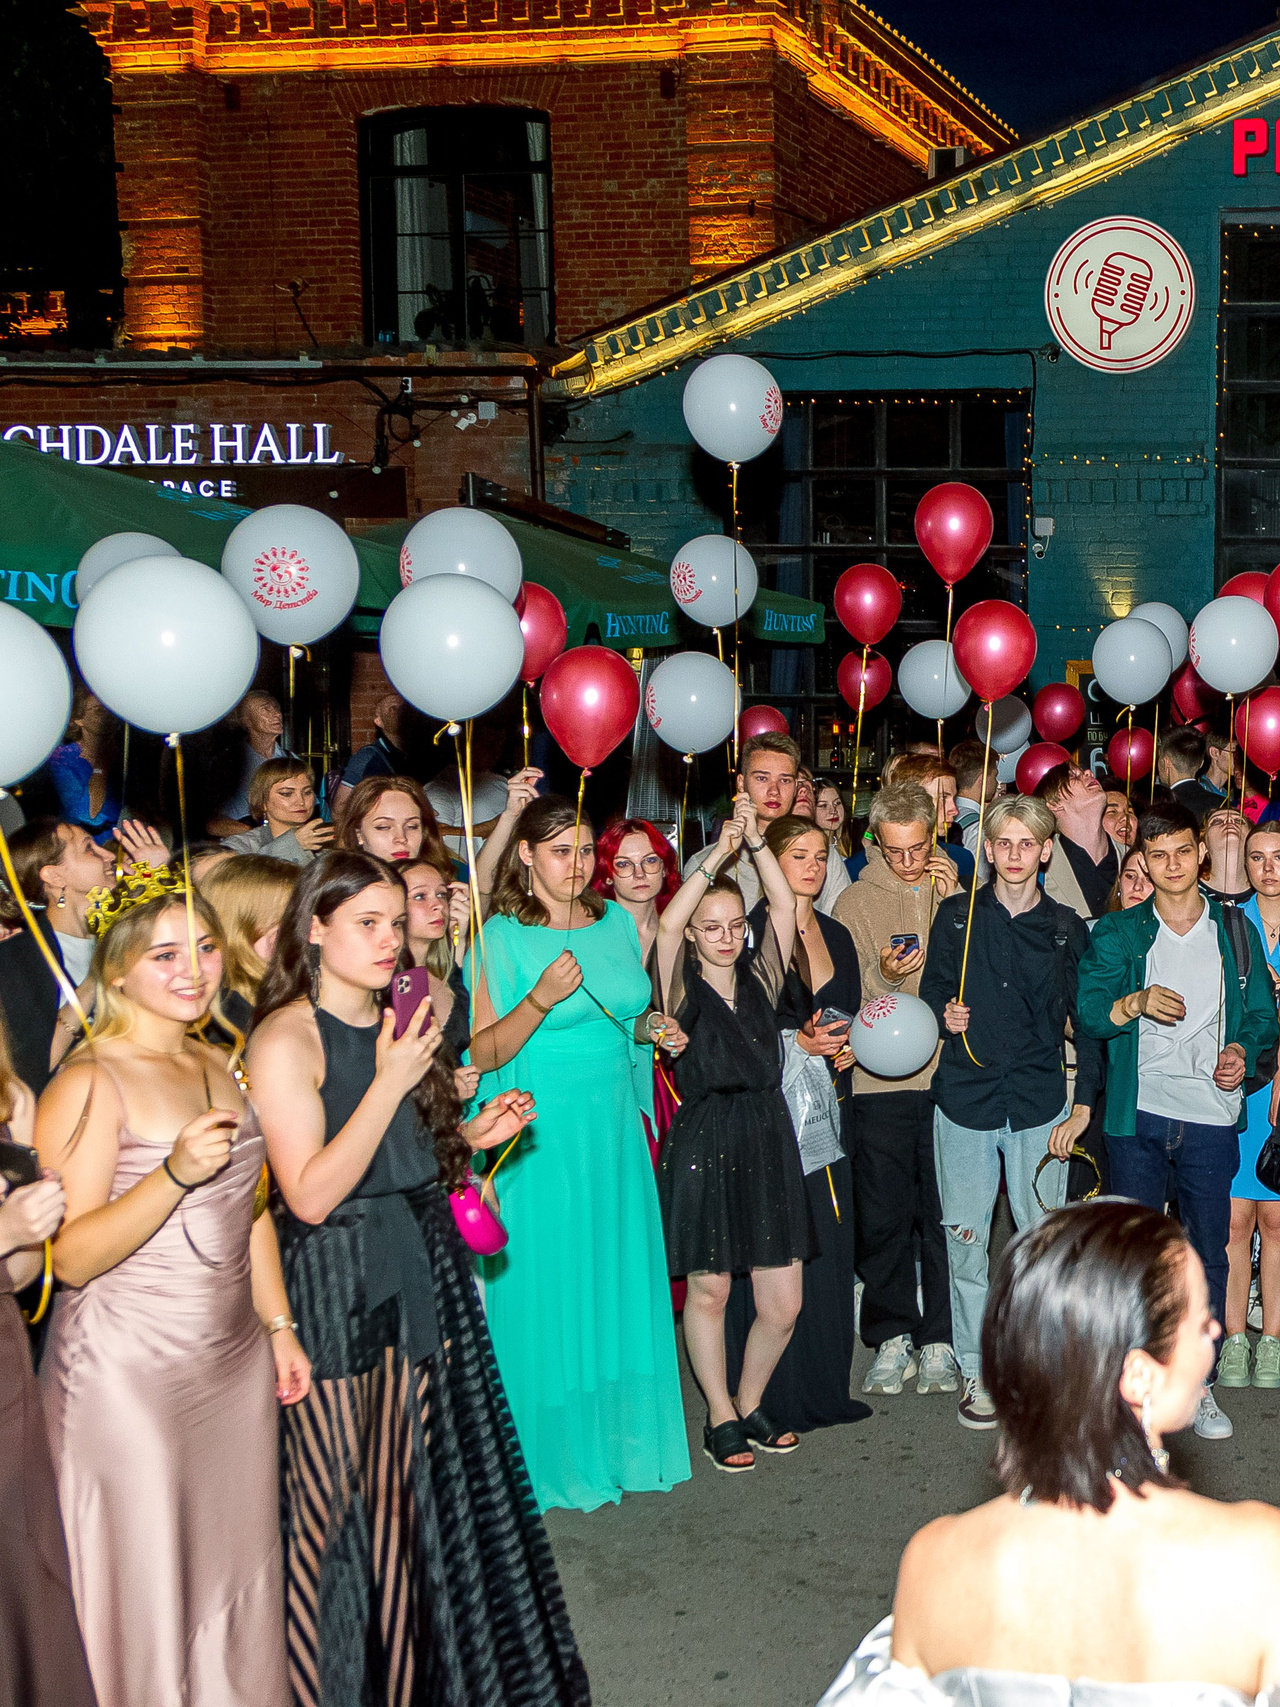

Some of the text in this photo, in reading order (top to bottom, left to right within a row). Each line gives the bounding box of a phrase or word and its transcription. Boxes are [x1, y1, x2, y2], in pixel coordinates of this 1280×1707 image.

[209, 422, 341, 465] HALL
[251, 588, 319, 610] Мир Детства
[606, 611, 669, 637] HUNTING
[804, 1110, 831, 1127] MEUCC
